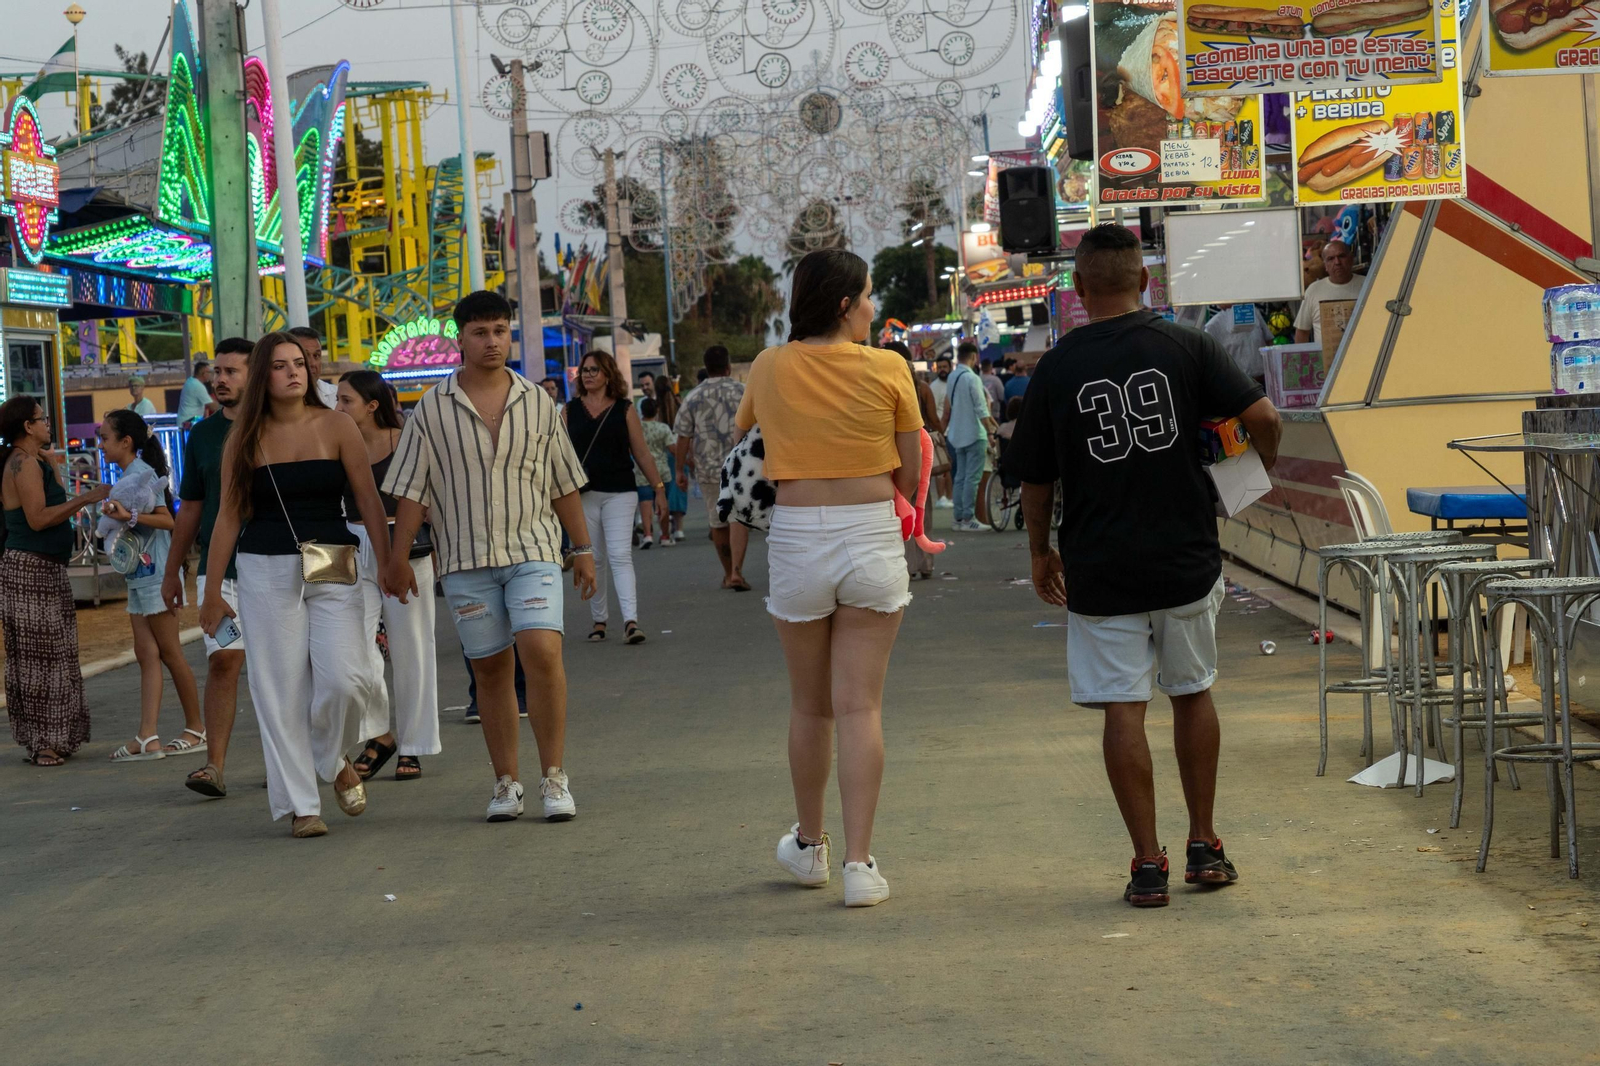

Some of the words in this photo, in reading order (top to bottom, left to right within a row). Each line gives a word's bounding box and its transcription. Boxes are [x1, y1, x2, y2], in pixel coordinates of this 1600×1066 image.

[1557, 48, 1600, 67] GRAC
[1301, 60, 1339, 79] CON
[1344, 58, 1370, 75] TU
[1313, 101, 1384, 120] BEBIDA
[1164, 152, 1189, 160] KEBAB
[1221, 169, 1260, 180] CLUIDA
[1102, 187, 1159, 200] Gracias
[1162, 186, 1191, 202] por
[1194, 187, 1212, 197] su
[1218, 184, 1260, 196] visita
[1341, 187, 1385, 199] GRACIAS
[1387, 185, 1408, 197] POR
[1411, 183, 1426, 196] SU
[1428, 182, 1461, 194] VISITA
[1077, 368, 1179, 463] 39
